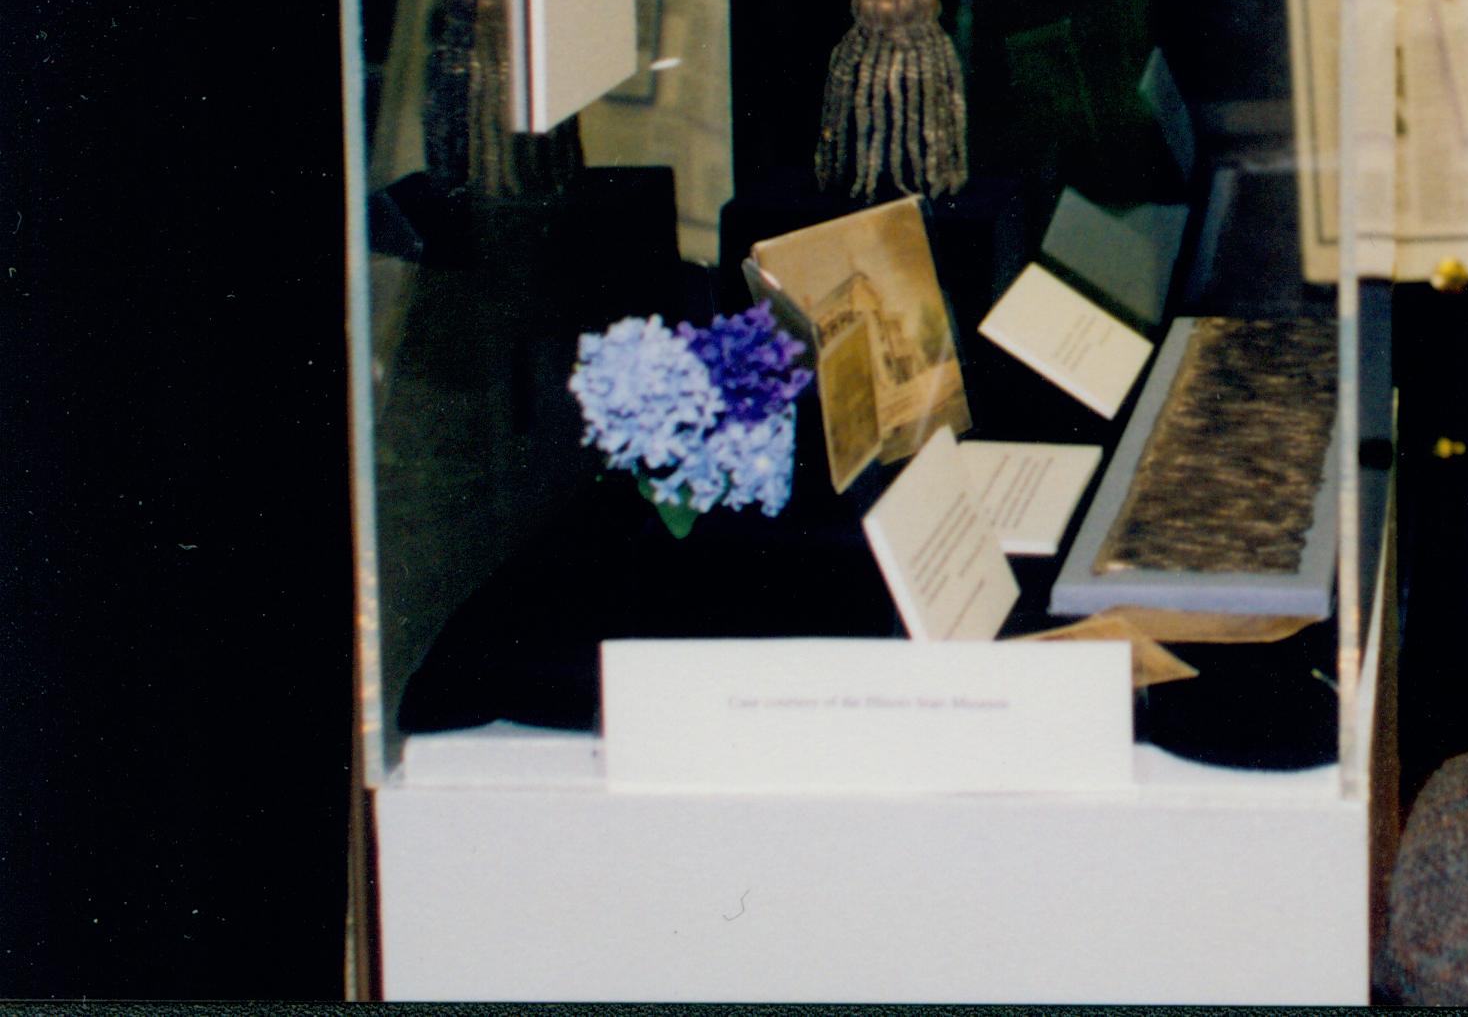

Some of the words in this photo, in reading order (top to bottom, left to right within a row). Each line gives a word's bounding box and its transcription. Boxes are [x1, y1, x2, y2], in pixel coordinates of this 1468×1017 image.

[763, 695, 818, 713] courtesy
[823, 693, 840, 710] of
[841, 693, 861, 710] the
